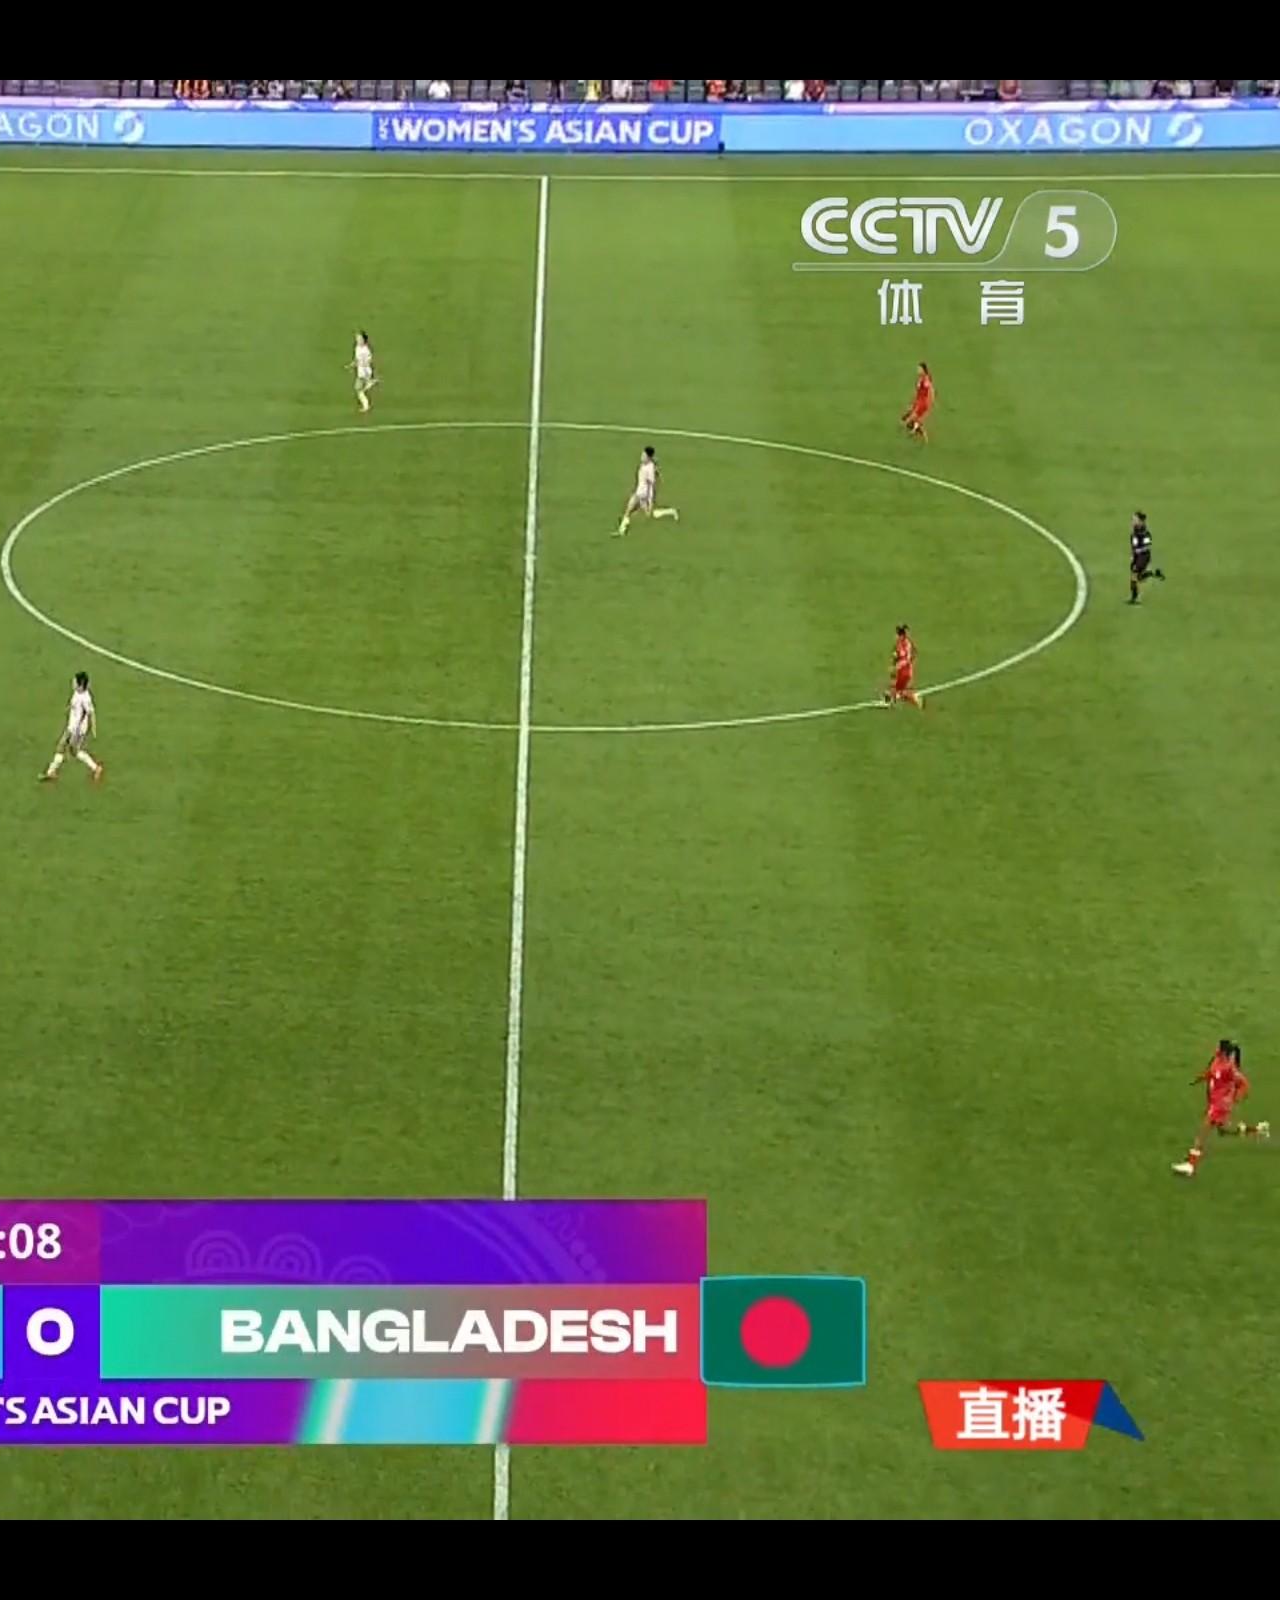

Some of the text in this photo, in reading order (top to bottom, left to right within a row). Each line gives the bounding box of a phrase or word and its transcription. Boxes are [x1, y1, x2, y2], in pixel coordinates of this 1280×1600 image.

[392, 117, 536, 143] WOMEN'S
[543, 118, 645, 144] ASIAN
[647, 118, 714, 145] CUP
[965, 115, 1151, 146] OXAGON
